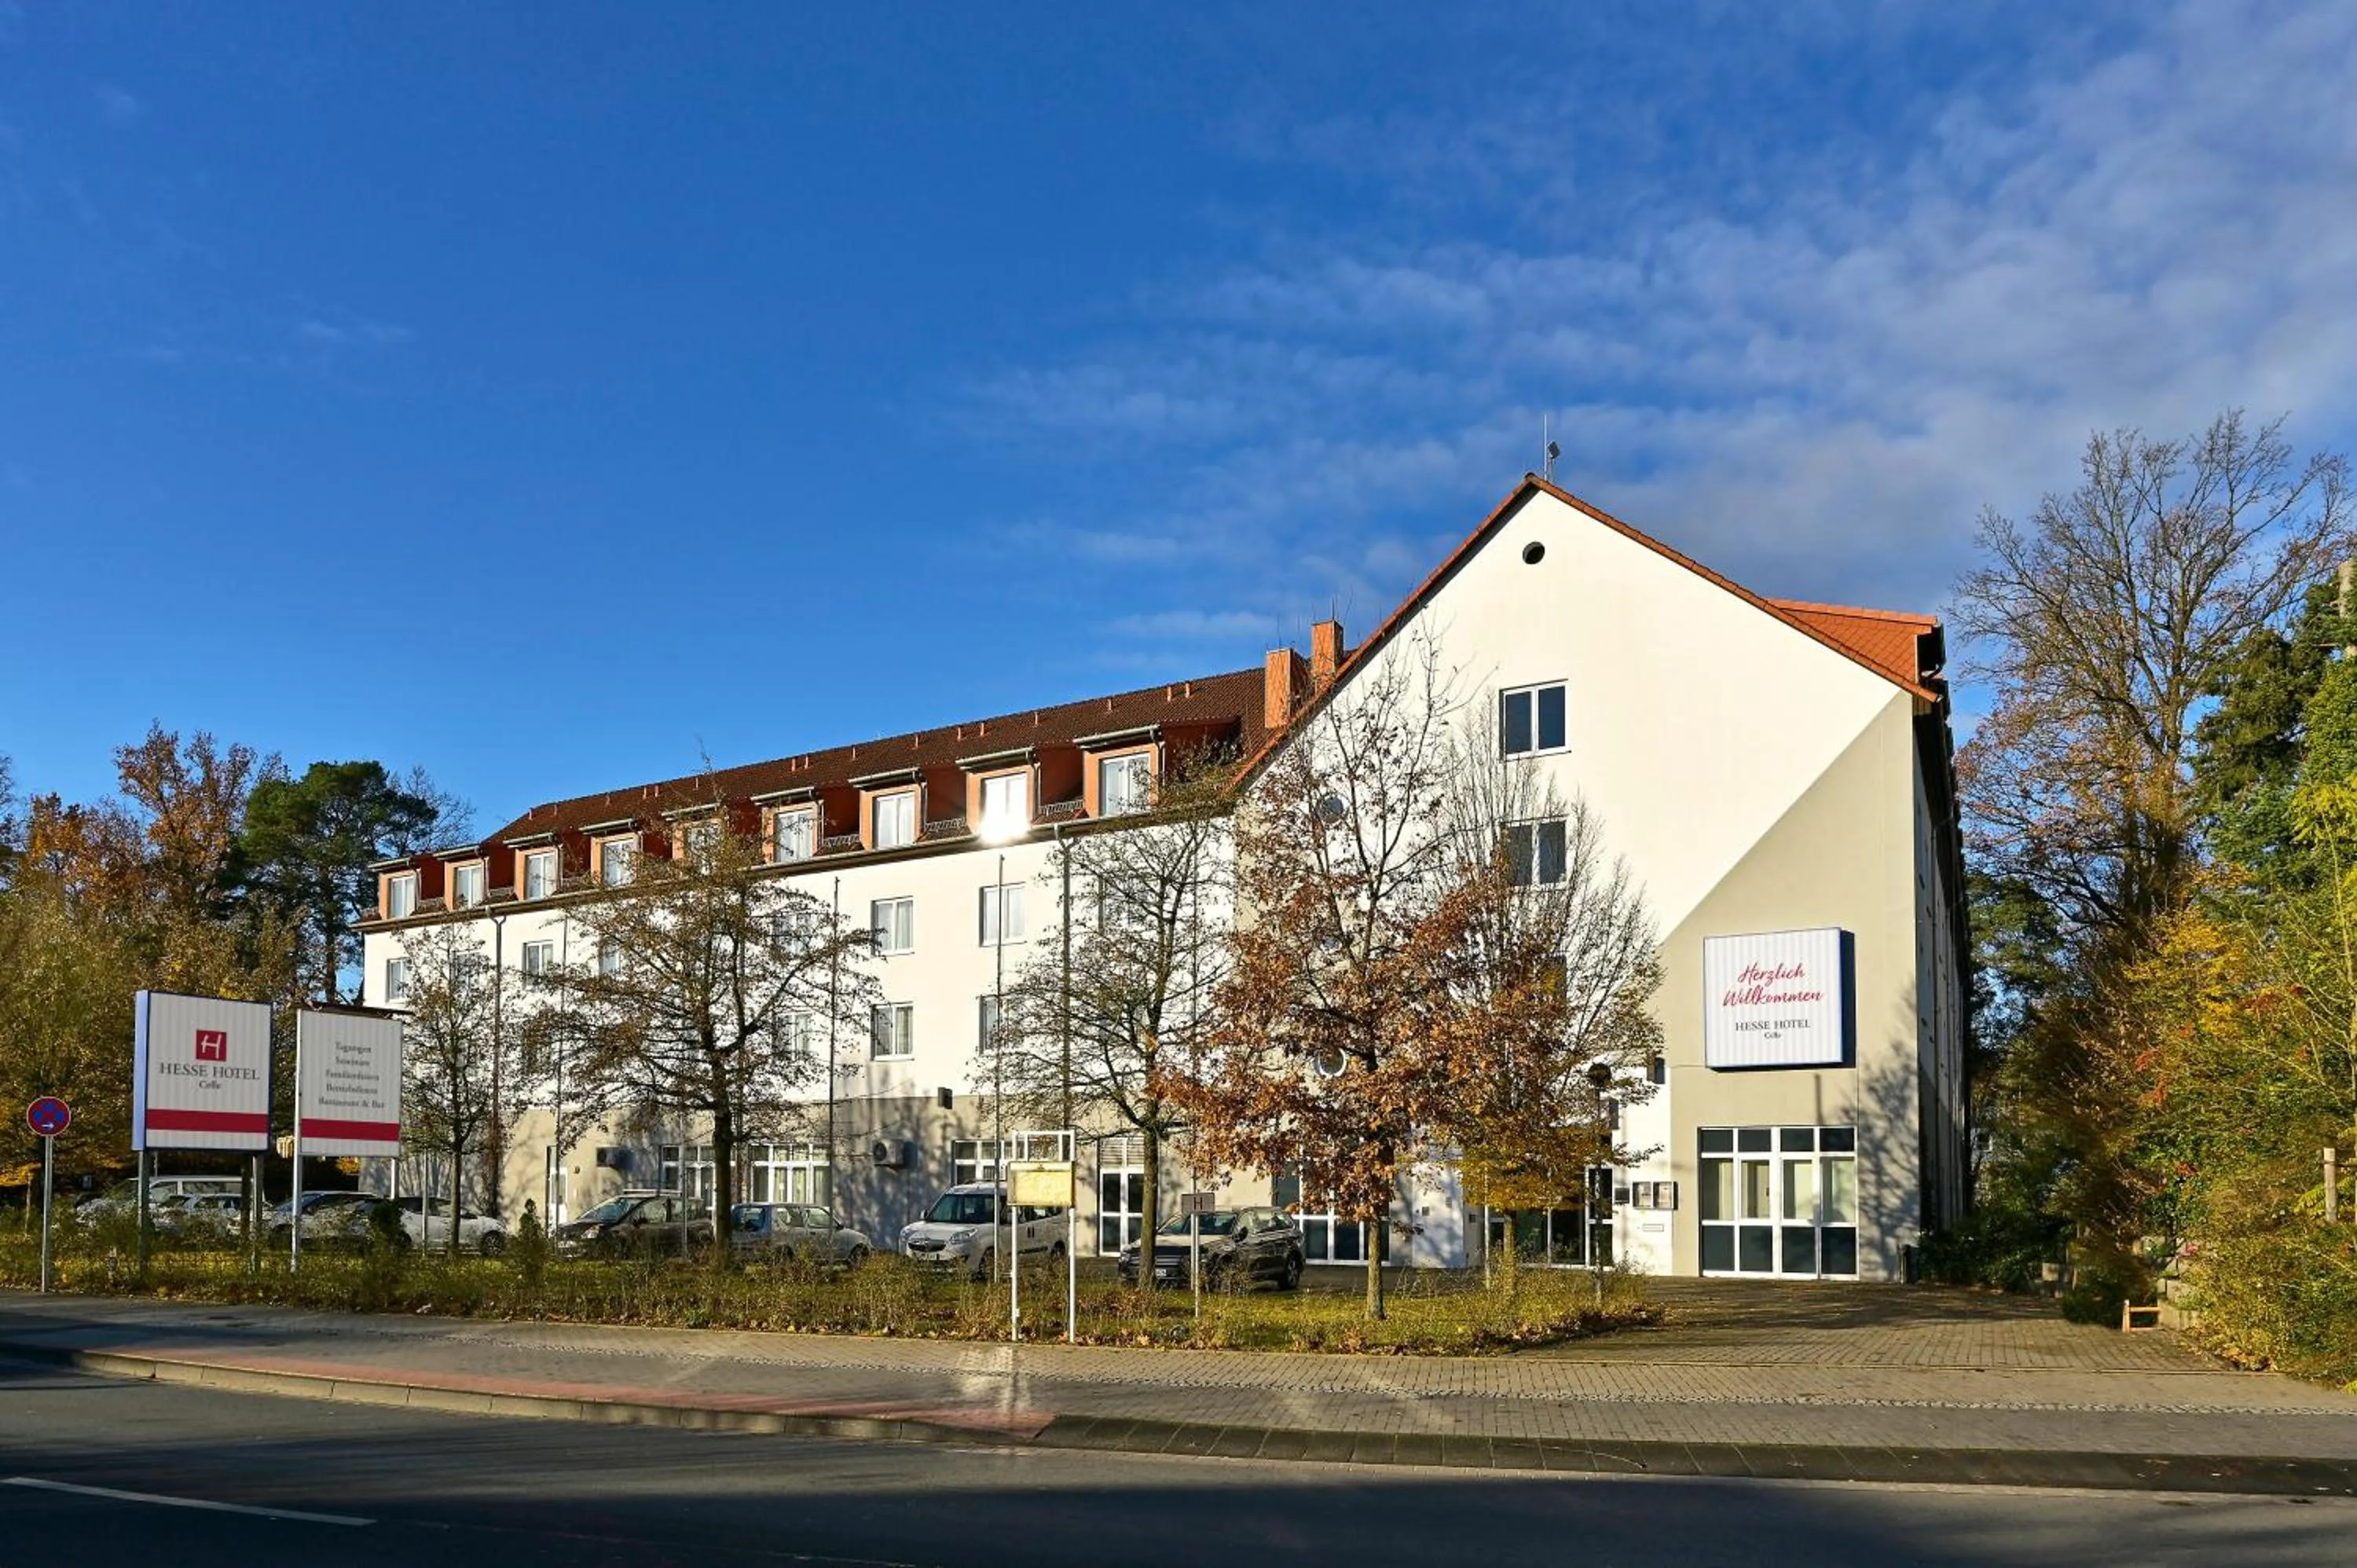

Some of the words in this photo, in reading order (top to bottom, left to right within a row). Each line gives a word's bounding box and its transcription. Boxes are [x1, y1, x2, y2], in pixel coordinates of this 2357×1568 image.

[1737, 962, 1805, 987] Herzlich
[1722, 984, 1824, 1006] Willkommen
[1736, 1020, 1770, 1031] HESSE
[1774, 1019, 1811, 1029] HOTEL
[159, 1062, 208, 1077] HESSE
[212, 1065, 261, 1080] HOTEL
